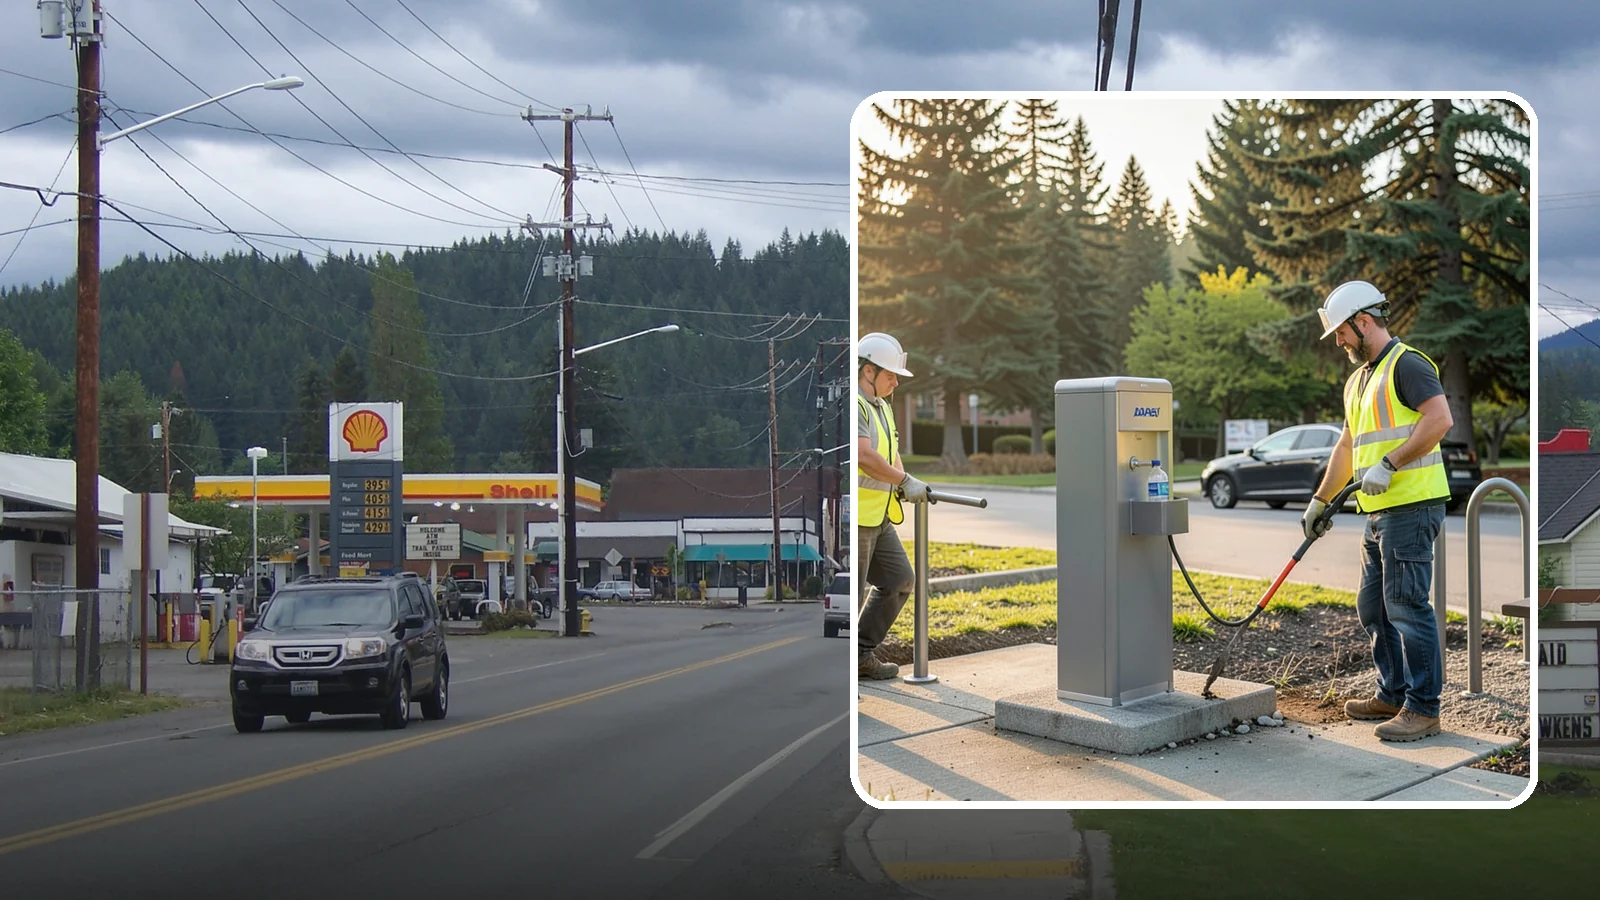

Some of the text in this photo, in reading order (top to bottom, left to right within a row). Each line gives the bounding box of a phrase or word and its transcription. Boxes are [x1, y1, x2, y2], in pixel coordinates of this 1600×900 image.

[366, 480, 384, 490] 395
[490, 484, 547, 499] Shell
[366, 494, 384, 504] 405
[366, 508, 384, 518] 415
[366, 522, 384, 532] 429
